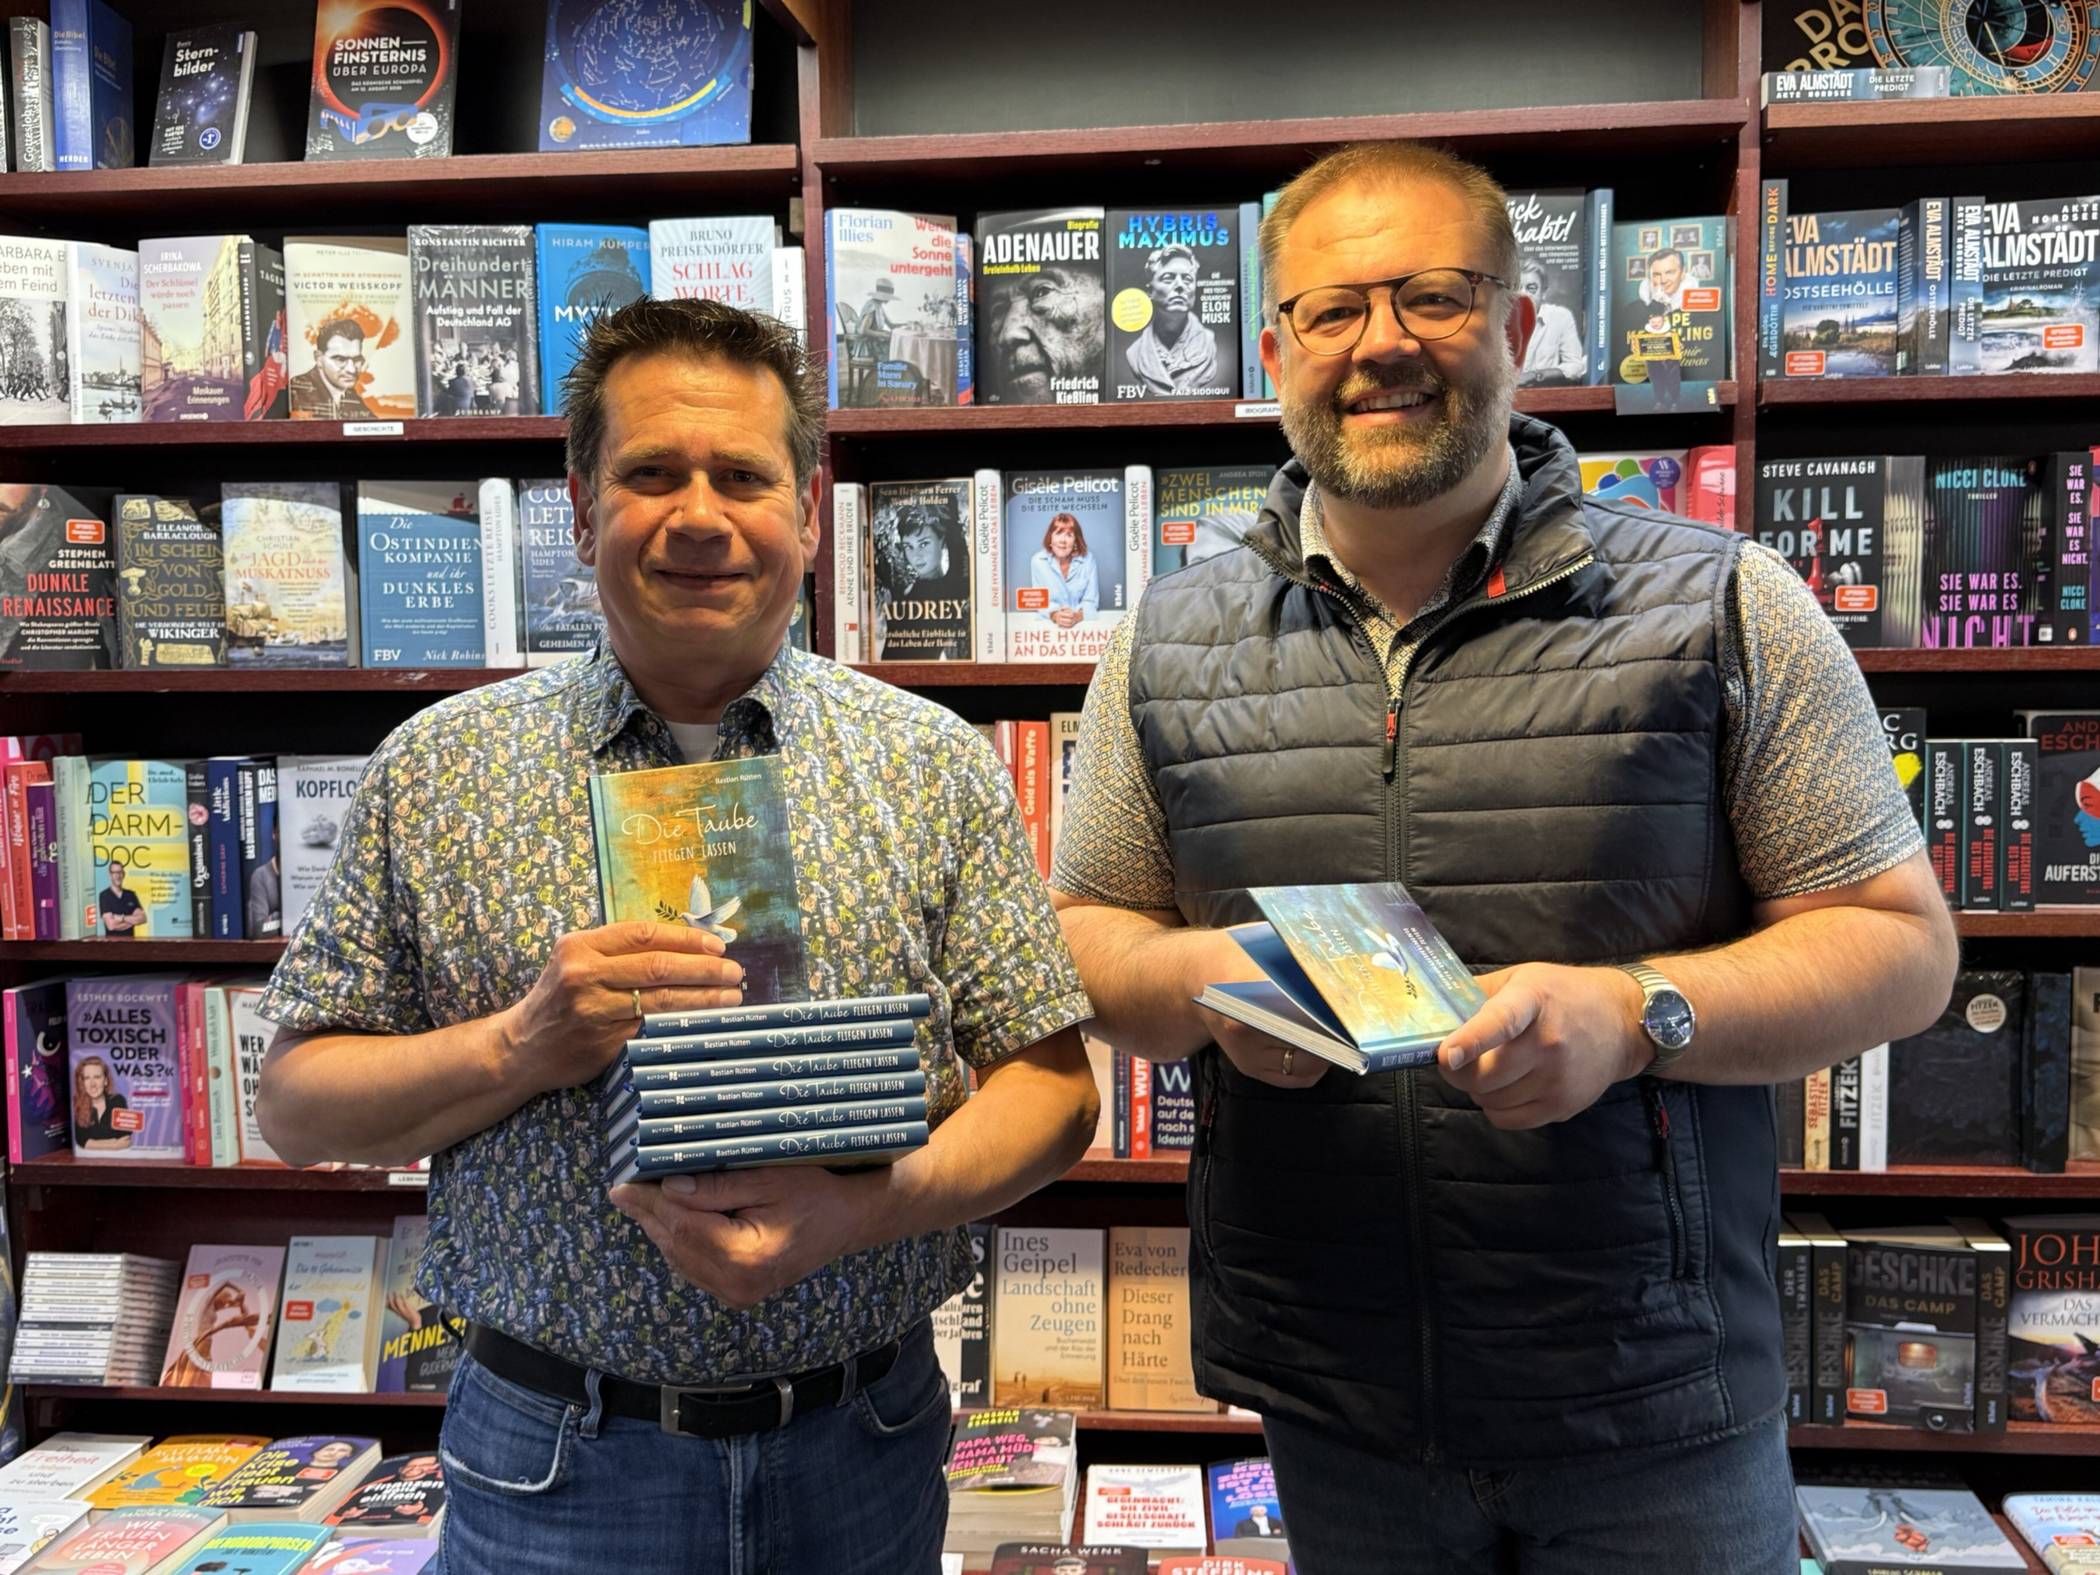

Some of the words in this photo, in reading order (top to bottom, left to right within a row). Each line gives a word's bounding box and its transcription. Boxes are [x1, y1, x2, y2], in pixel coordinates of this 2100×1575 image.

[335, 37, 400, 51] SONNEN
[175, 47, 219, 63] Stern-
[334, 49, 427, 64] FINSTERNIS
[173, 61, 215, 77] bilder
[332, 65, 368, 77] ÜBER
[373, 63, 427, 75] EUROPA
[1776, 75, 1797, 91] EVA
[1800, 70, 1854, 90] ALMSTÄDT
[1885, 74, 1915, 83] LETZTE
[1874, 83, 1909, 92] PREDIGT
[1767, 187, 1778, 224] DARK
[1927, 201, 1941, 221] EVA
[839, 214, 893, 230] Florian
[915, 218, 951, 232] Wenn
[1067, 220, 1098, 230] Biografie
[1129, 213, 1217, 232] HYBRIS
[415, 238, 479, 247] KONSTANTIN
[482, 238, 526, 247] RICHTER
[690, 230, 733, 242] BRUNO
[839, 230, 874, 242] Illies
[932, 236, 951, 248] die
[1119, 228, 1229, 248] MAXIMUS
[552, 238, 593, 249] HIRAM
[661, 242, 764, 258] PREISENDÖRFER
[983, 231, 1099, 264] ADENAUER
[160, 250, 183, 262] IRINA
[912, 247, 951, 261] Sonne
[1926, 223, 1941, 281] ALMSTÄDT
[143, 262, 202, 273] SCHERBAKOWA
[418, 255, 527, 273] Dreihundert
[672, 261, 752, 280] SCHLAG
[890, 263, 953, 277] untergeht
[33, 267, 54, 277] mit
[1766, 253, 1777, 297] HOME
[2003, 271, 2041, 281] LETZTE
[2043, 267, 2088, 278] PREDIGT
[22, 279, 58, 293] Feind
[161, 277, 199, 288] Schlüssel
[294, 281, 334, 291] VICTOR
[338, 281, 403, 291] WEISSKOPF
[418, 275, 527, 299] MÄNNER
[89, 285, 136, 305] letzten
[176, 289, 196, 298] noch
[162, 301, 189, 311] passen
[426, 305, 464, 317] Aufstieg
[466, 305, 484, 315] und
[486, 305, 503, 315] Fall
[505, 305, 522, 315] der
[1202, 302, 1230, 312] ELON
[436, 316, 493, 328] Deutschland
[495, 317, 512, 327] AG
[1202, 312, 1230, 323] MUSK
[1050, 377, 1098, 391] Friedrich
[1057, 391, 1099, 405] Kießling
[1117, 386, 1147, 398] FBV
[1763, 463, 1802, 478] STEVE
[1807, 461, 1876, 476] CAVANAGH
[1161, 473, 1210, 487] »ZWEI
[1936, 469, 1977, 488] NICCI
[1983, 467, 2027, 487] CLOKE
[1012, 477, 1060, 494] Gisèle
[1063, 476, 1119, 493] Pelicot
[1045, 496, 1074, 504] SCHAM
[1161, 487, 1268, 502] MENSCHEN
[1034, 504, 1059, 512] SEITE
[1062, 503, 1108, 512] WECHSELN
[1161, 502, 1200, 517] SIND
[1206, 502, 1223, 515] IN
[1773, 486, 1863, 522] KILL
[156, 524, 203, 532] ELEANOR
[390, 517, 414, 530] Die
[143, 532, 217, 540] BARRACLOUGH
[1760, 530, 1818, 557] FOR
[1830, 528, 1873, 556] ME
[58, 549, 106, 559] STEPHEN
[250, 552, 301, 567] JAGD
[384, 553, 472, 564] KOMPANIE
[163, 564, 201, 578] VON
[235, 567, 331, 580] MUSKATNUSS
[27, 574, 89, 593] DUNKLE
[383, 583, 474, 595] DUNKLES
[1940, 573, 1963, 591] SIE
[1969, 573, 1997, 590] WAR
[2003, 573, 2022, 590] ES.
[158, 584, 207, 598] GOLD
[3, 598, 114, 617] RENAISSANCE
[405, 596, 454, 609] ERBE
[132, 604, 170, 617] UND
[488, 590, 496, 630] COOKS
[881, 600, 967, 620] AUDREY
[148, 629, 220, 639] WIKINGER
[1014, 632, 1051, 643] EINE
[374, 650, 401, 661] FBV
[423, 650, 448, 661] Nick
[1014, 645, 1035, 657] AN
[1039, 645, 1067, 657] DAS
[1025, 730, 1036, 770] Waffe
[715, 775, 738, 785] Bastian
[740, 773, 762, 783] Rütten
[1025, 772, 1035, 791] als
[1974, 748, 1985, 812] ESCHBACH
[86, 782, 146, 805] DER
[1025, 793, 1036, 815] Geld
[90, 813, 183, 836] DARM-
[621, 813, 684, 845] Die
[675, 803, 758, 837] Taube
[93, 846, 152, 869] DOC
[653, 846, 694, 864] FLIEGEN
[702, 842, 737, 858] LASSEN
[83, 1009, 152, 1024] »ALLES
[721, 1015, 744, 1024] Bastian
[783, 1007, 814, 1024] Die
[811, 1004, 850, 1020] Taube
[853, 1003, 881, 1017] FLIEGEN
[884, 1002, 909, 1014] LASSEN
[76, 1028, 165, 1044] TOXISCH
[240, 1035, 265, 1053] WER
[110, 1048, 158, 1060] ODER
[113, 1064, 175, 1077] WAS?«
[1840, 1059, 1858, 1128] FITZEK
[1157, 1107, 1176, 1119] auf
[1157, 1121, 1187, 1132] nach
[1004, 1232, 1049, 1251] Ines
[1115, 1242, 1143, 1257] Eva
[1148, 1244, 1176, 1257] von
[1004, 1253, 1077, 1279] Geipel
[1115, 1260, 1187, 1277] Redecker
[1002, 1280, 1096, 1297] Landschaft
[1122, 1288, 1172, 1304] Dieser
[1052, 1297, 1096, 1314] ohne
[1865, 1296, 1898, 1310] DAS
[1904, 1298, 1956, 1314] CAMP
[2064, 1298, 2092, 1311] DAS
[1030, 1315, 1096, 1336] Zeugen
[1122, 1309, 1172, 1328] Drang
[1122, 1329, 1161, 1345] nach
[1122, 1352, 1168, 1367] Härte
[956, 1436, 991, 1449] PAPA
[995, 1434, 1030, 1445] WEG.
[24, 1453, 99, 1466] Freiheit
[254, 1451, 290, 1461] Die
[953, 1447, 997, 1461] MAMA
[950, 1460, 975, 1471] ICH
[232, 1467, 279, 1480] liebt
[220, 1476, 295, 1488] Frauen
[360, 1492, 427, 1503] einfach
[126, 1521, 165, 1530] WIE
[1097, 1520, 1147, 1528] SCHLÄGT
[1151, 1519, 1195, 1528] ZURÜCK
[90, 1531, 171, 1541] FRAUEN
[75, 1541, 157, 1550] LÄNGER
[1021, 1546, 1072, 1555] SACHA
[1077, 1546, 1122, 1555] WENK
[70, 1551, 135, 1560] LEBEN
[1203, 1560, 1244, 1568] DIRK
